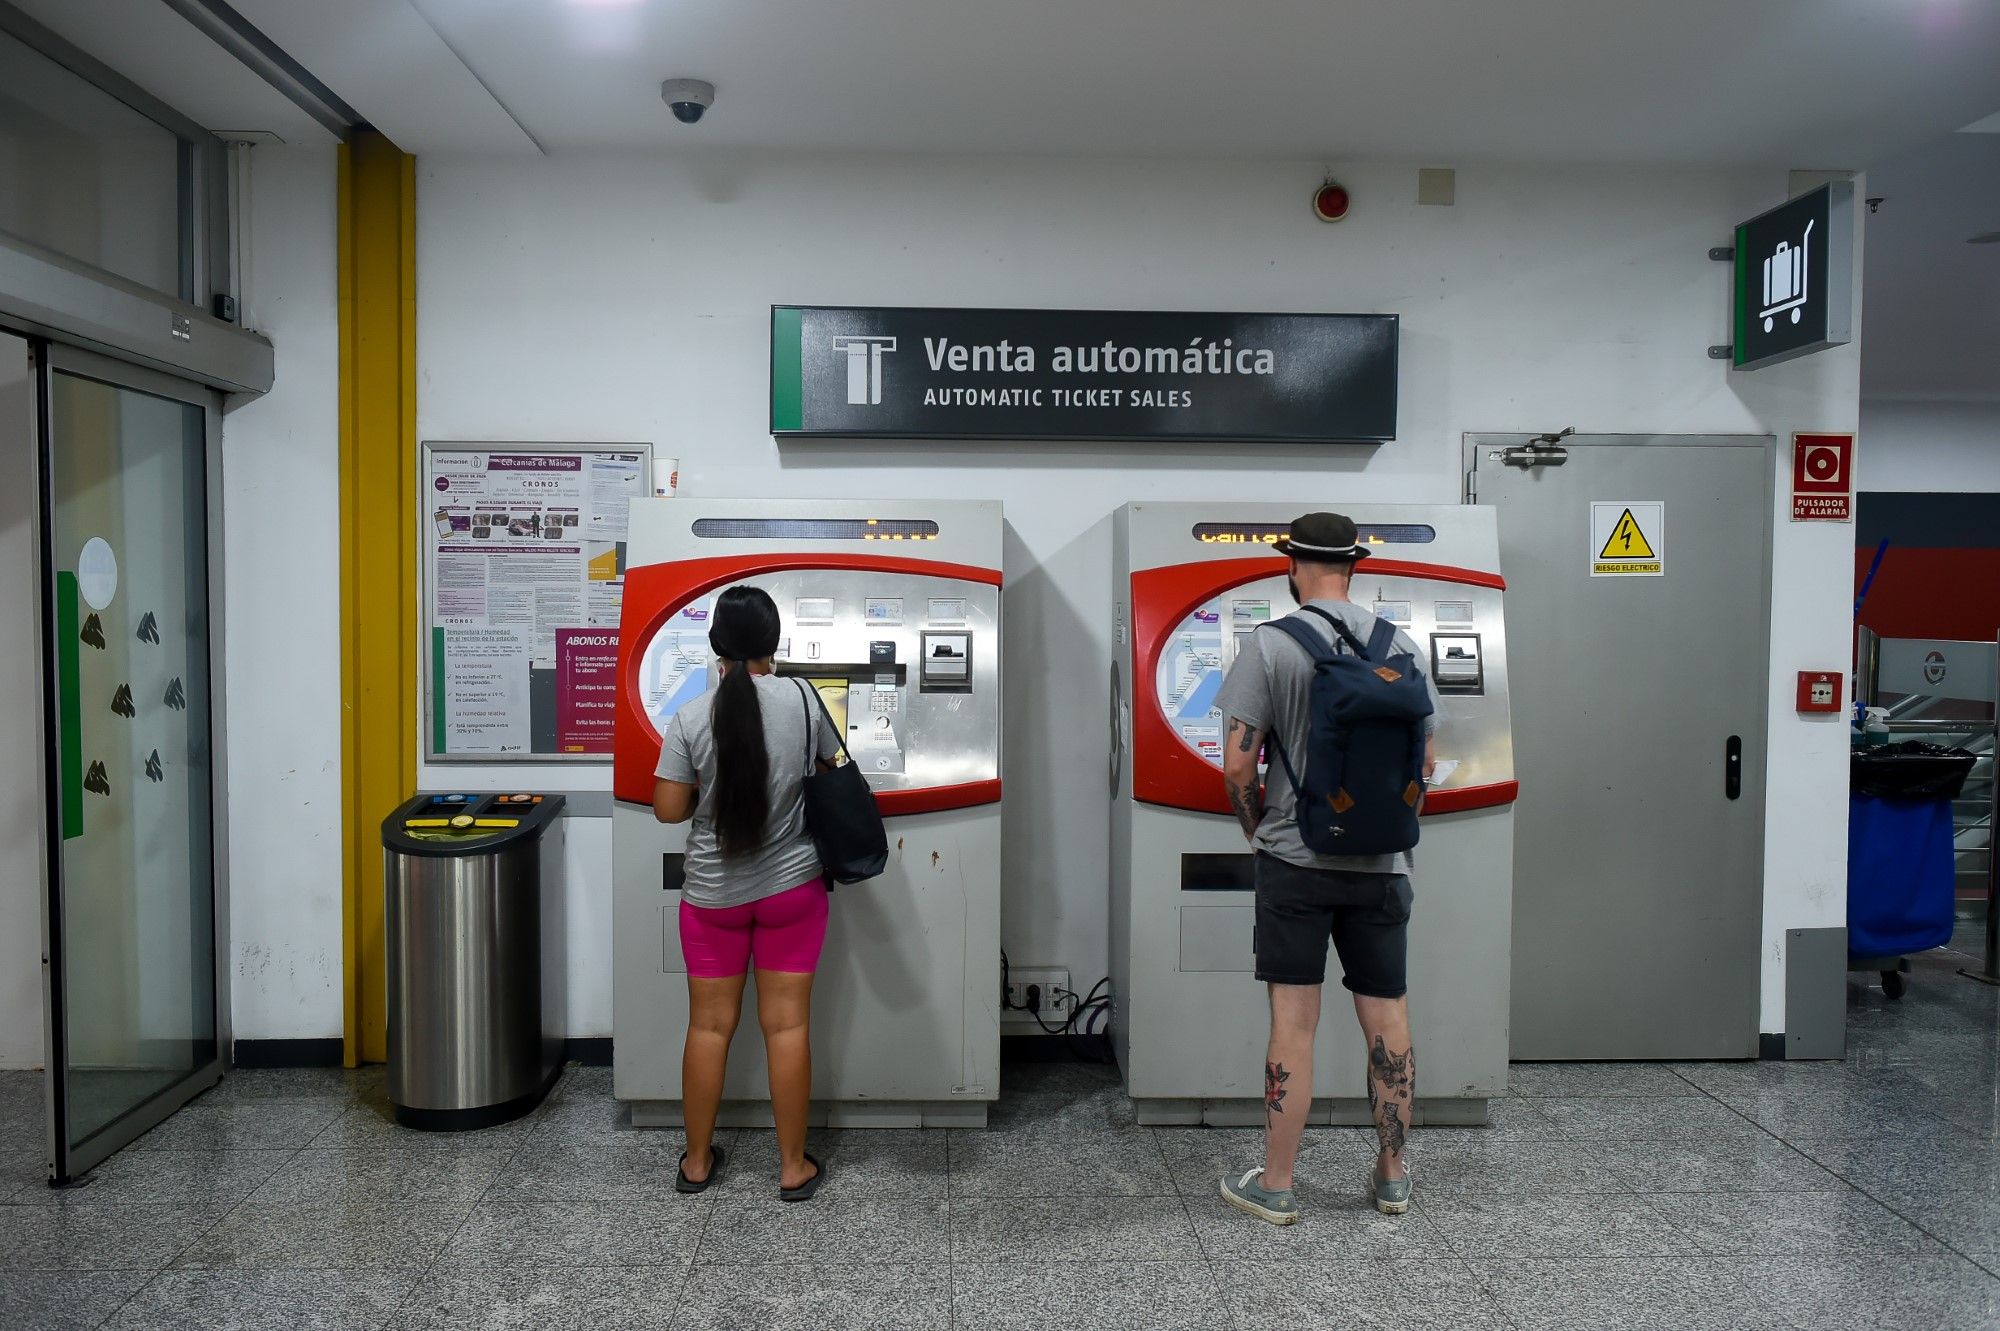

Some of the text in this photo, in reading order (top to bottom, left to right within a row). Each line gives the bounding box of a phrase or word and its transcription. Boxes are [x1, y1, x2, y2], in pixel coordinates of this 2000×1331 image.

[923, 337, 1274, 374] Venta automática
[923, 388, 1192, 408] AUTOMATIC TICKET SALES
[538, 458, 547, 466] de
[1797, 499, 1844, 507] PULSADOR
[566, 636, 607, 646] ABONOS
